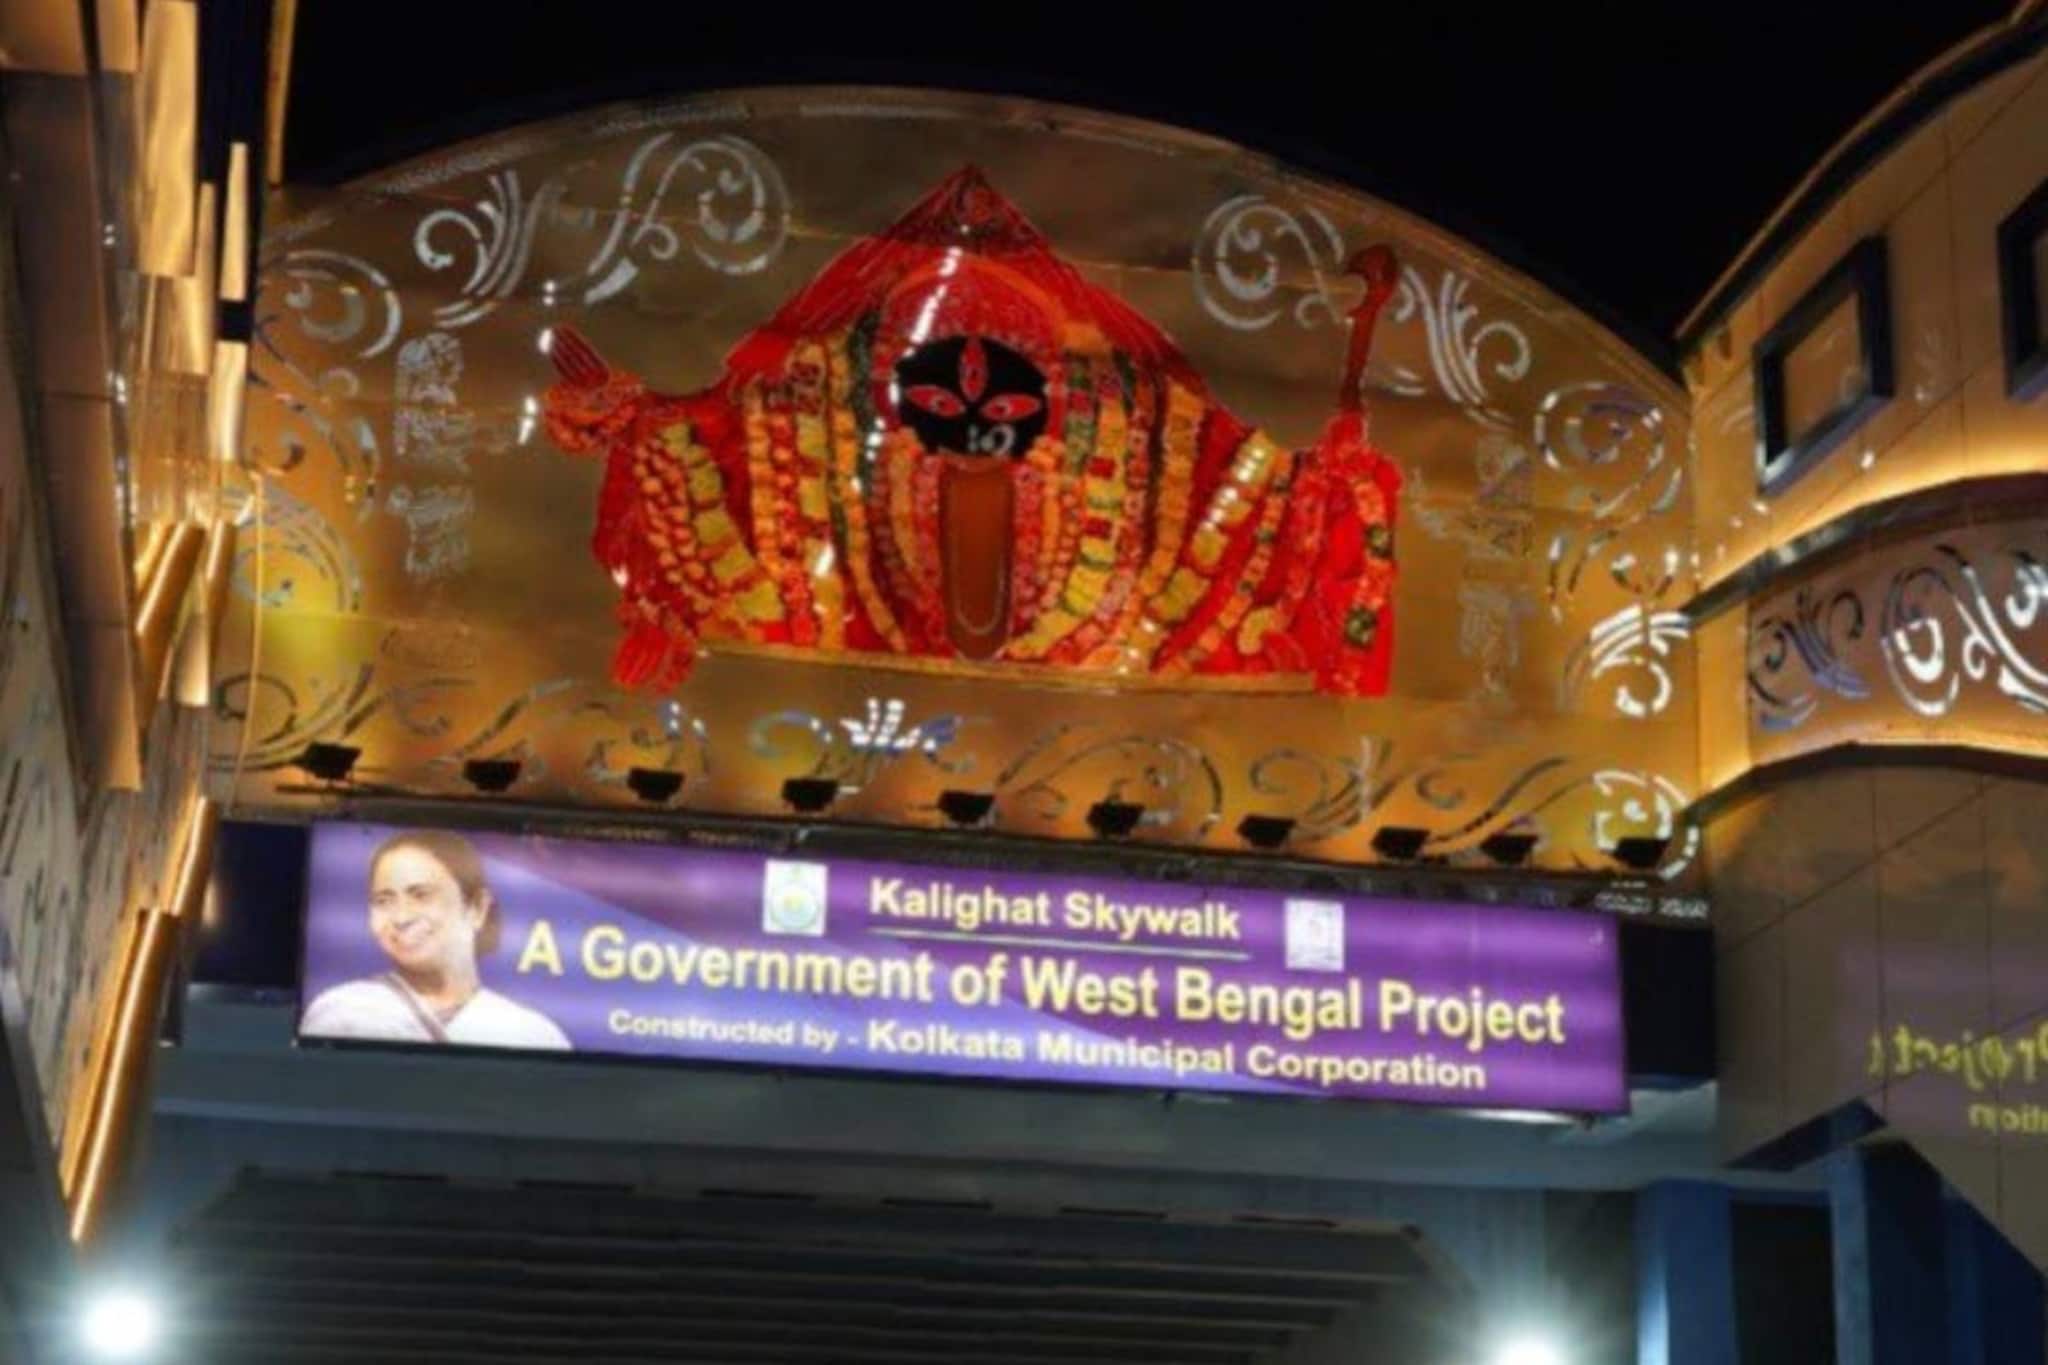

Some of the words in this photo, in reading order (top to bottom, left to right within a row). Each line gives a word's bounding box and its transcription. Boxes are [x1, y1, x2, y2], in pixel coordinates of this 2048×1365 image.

[869, 877, 1050, 929] Kalighat
[1064, 891, 1241, 940] Skywalk
[519, 919, 562, 976] A
[582, 924, 932, 1003] Government
[951, 952, 1007, 1007] of
[1021, 958, 1157, 1018] West
[1176, 967, 1362, 1040] Bengal
[1379, 979, 1565, 1052] Project
[608, 1009, 792, 1046] Constructed
[802, 1019, 840, 1053] by
[867, 1019, 1025, 1062] Kolkata
[1038, 1031, 1234, 1077] Municipal
[1246, 1043, 1486, 1090] Corporation
